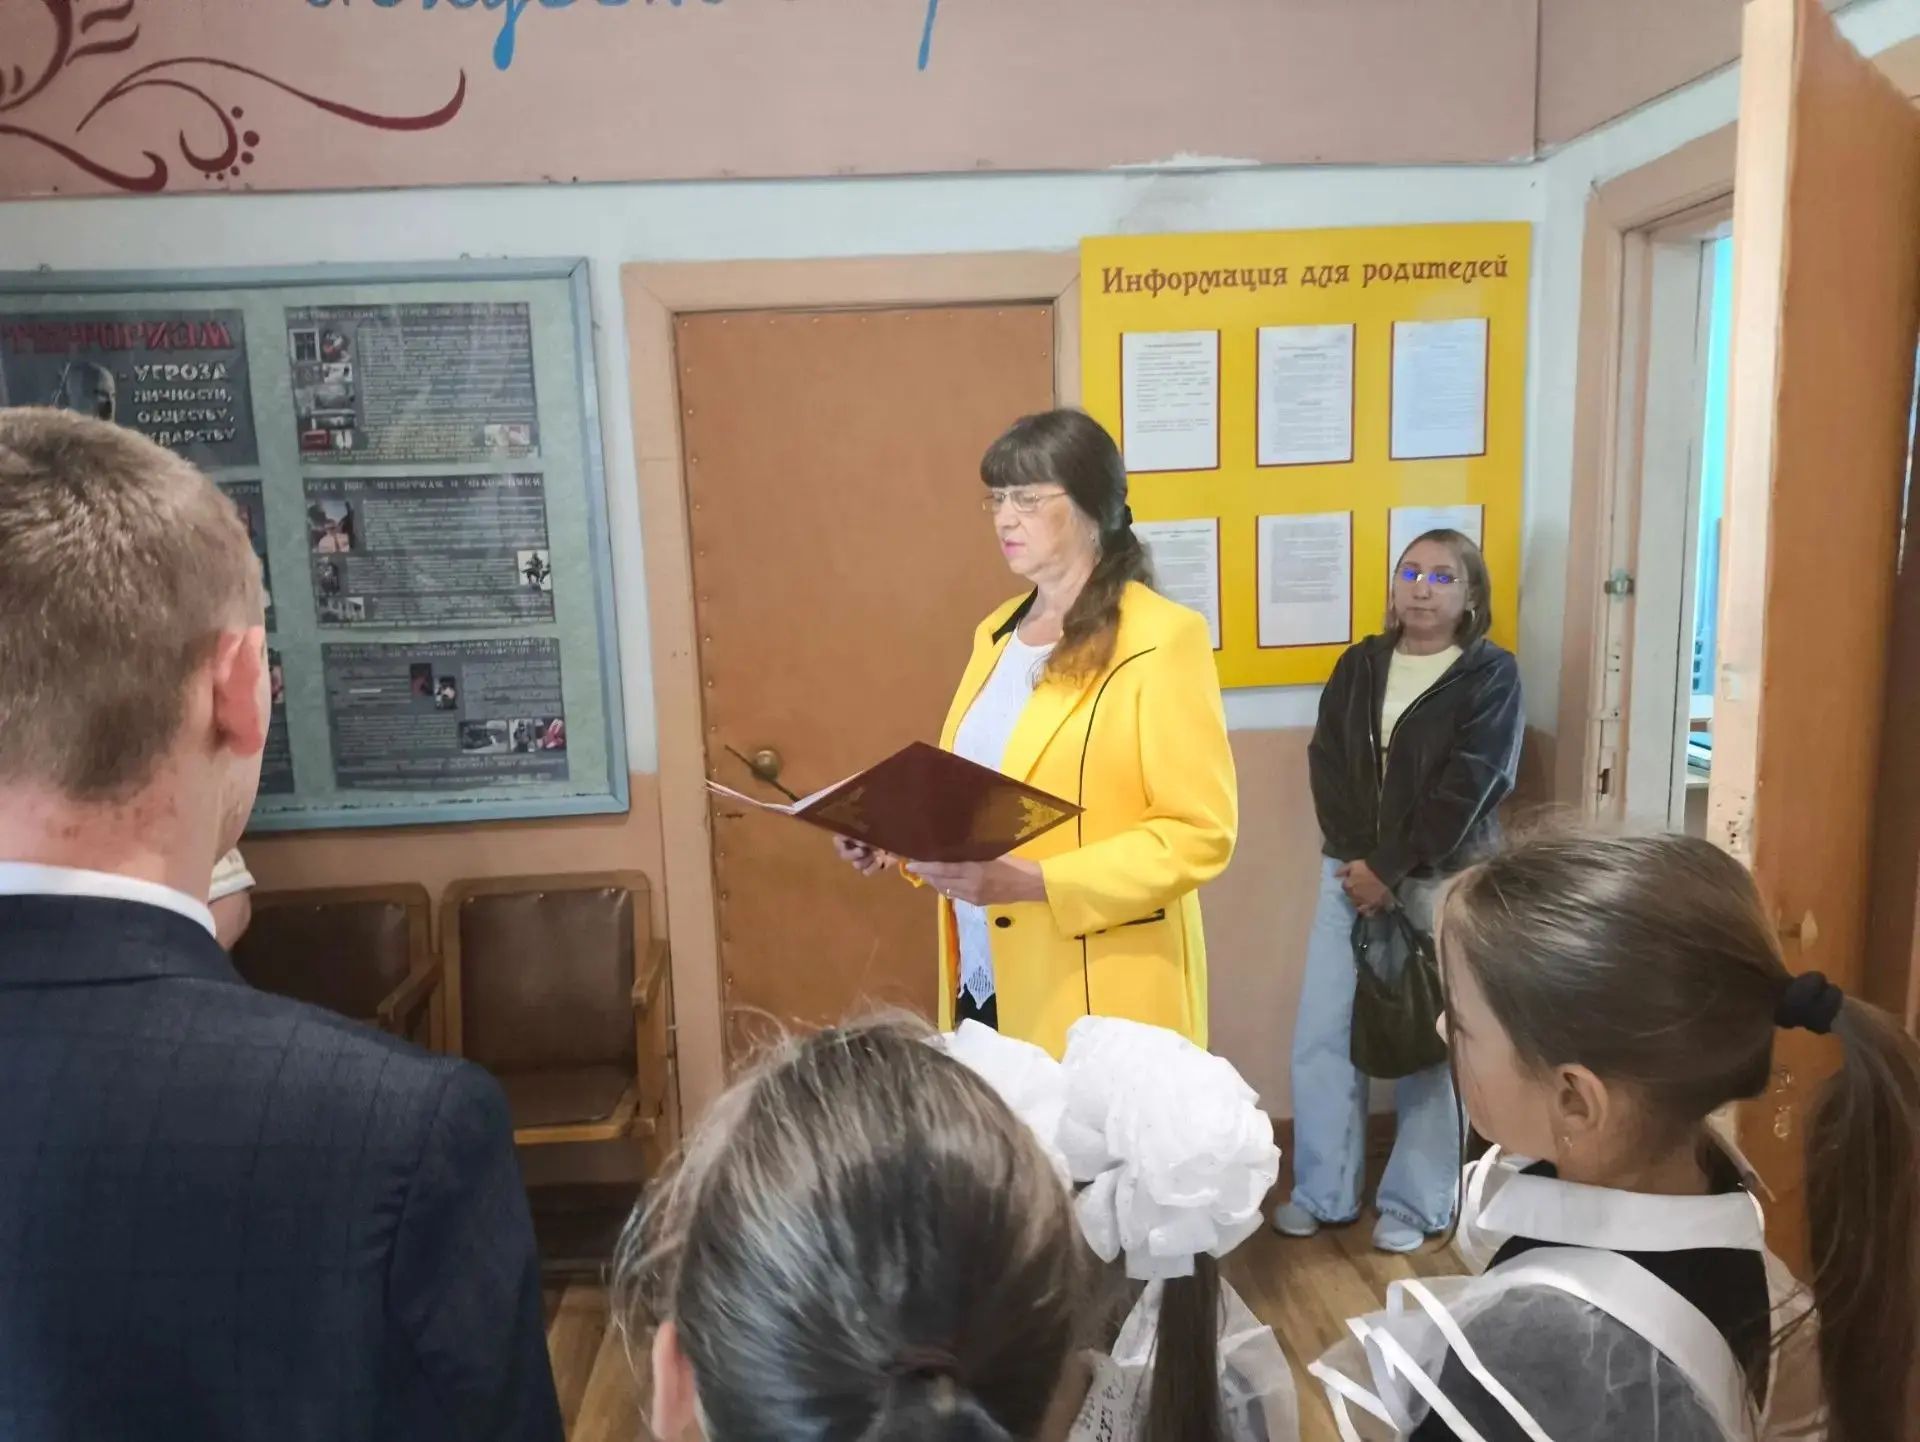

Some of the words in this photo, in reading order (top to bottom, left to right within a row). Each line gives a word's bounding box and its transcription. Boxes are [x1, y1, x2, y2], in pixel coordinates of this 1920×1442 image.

[1101, 266, 1289, 298] Информация
[1300, 264, 1351, 288] для
[1361, 254, 1509, 288] родителей
[133, 362, 229, 382] УГРОЗА
